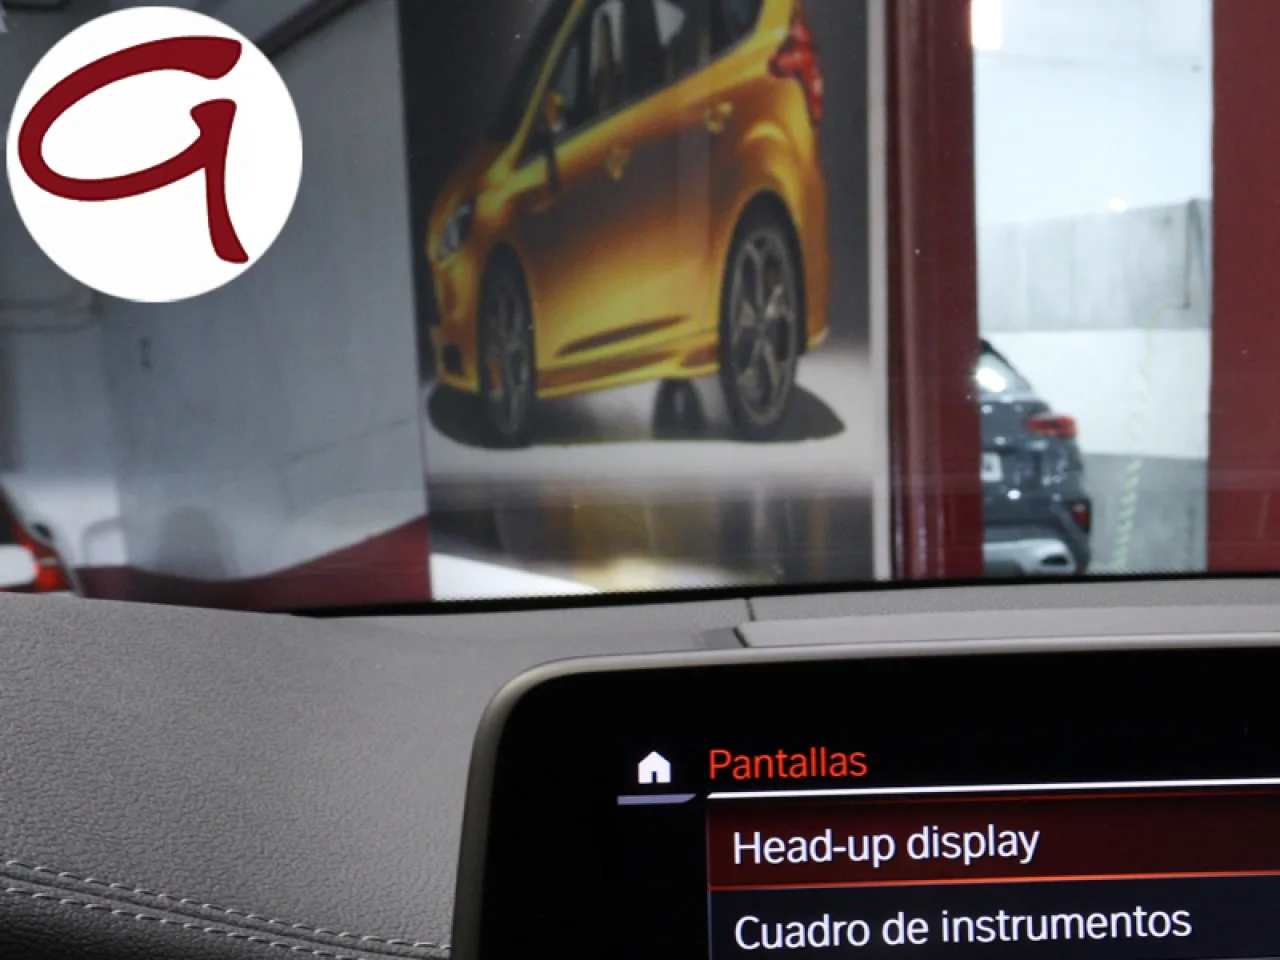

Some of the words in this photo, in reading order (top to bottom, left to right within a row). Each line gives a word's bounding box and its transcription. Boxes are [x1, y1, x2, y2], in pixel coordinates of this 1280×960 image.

[709, 746, 868, 781] Pantallas
[733, 828, 897, 870] Head-up
[906, 823, 1041, 868] display
[734, 912, 871, 950] Cuadro
[881, 911, 930, 946] de
[941, 905, 1193, 944] instrumentos
